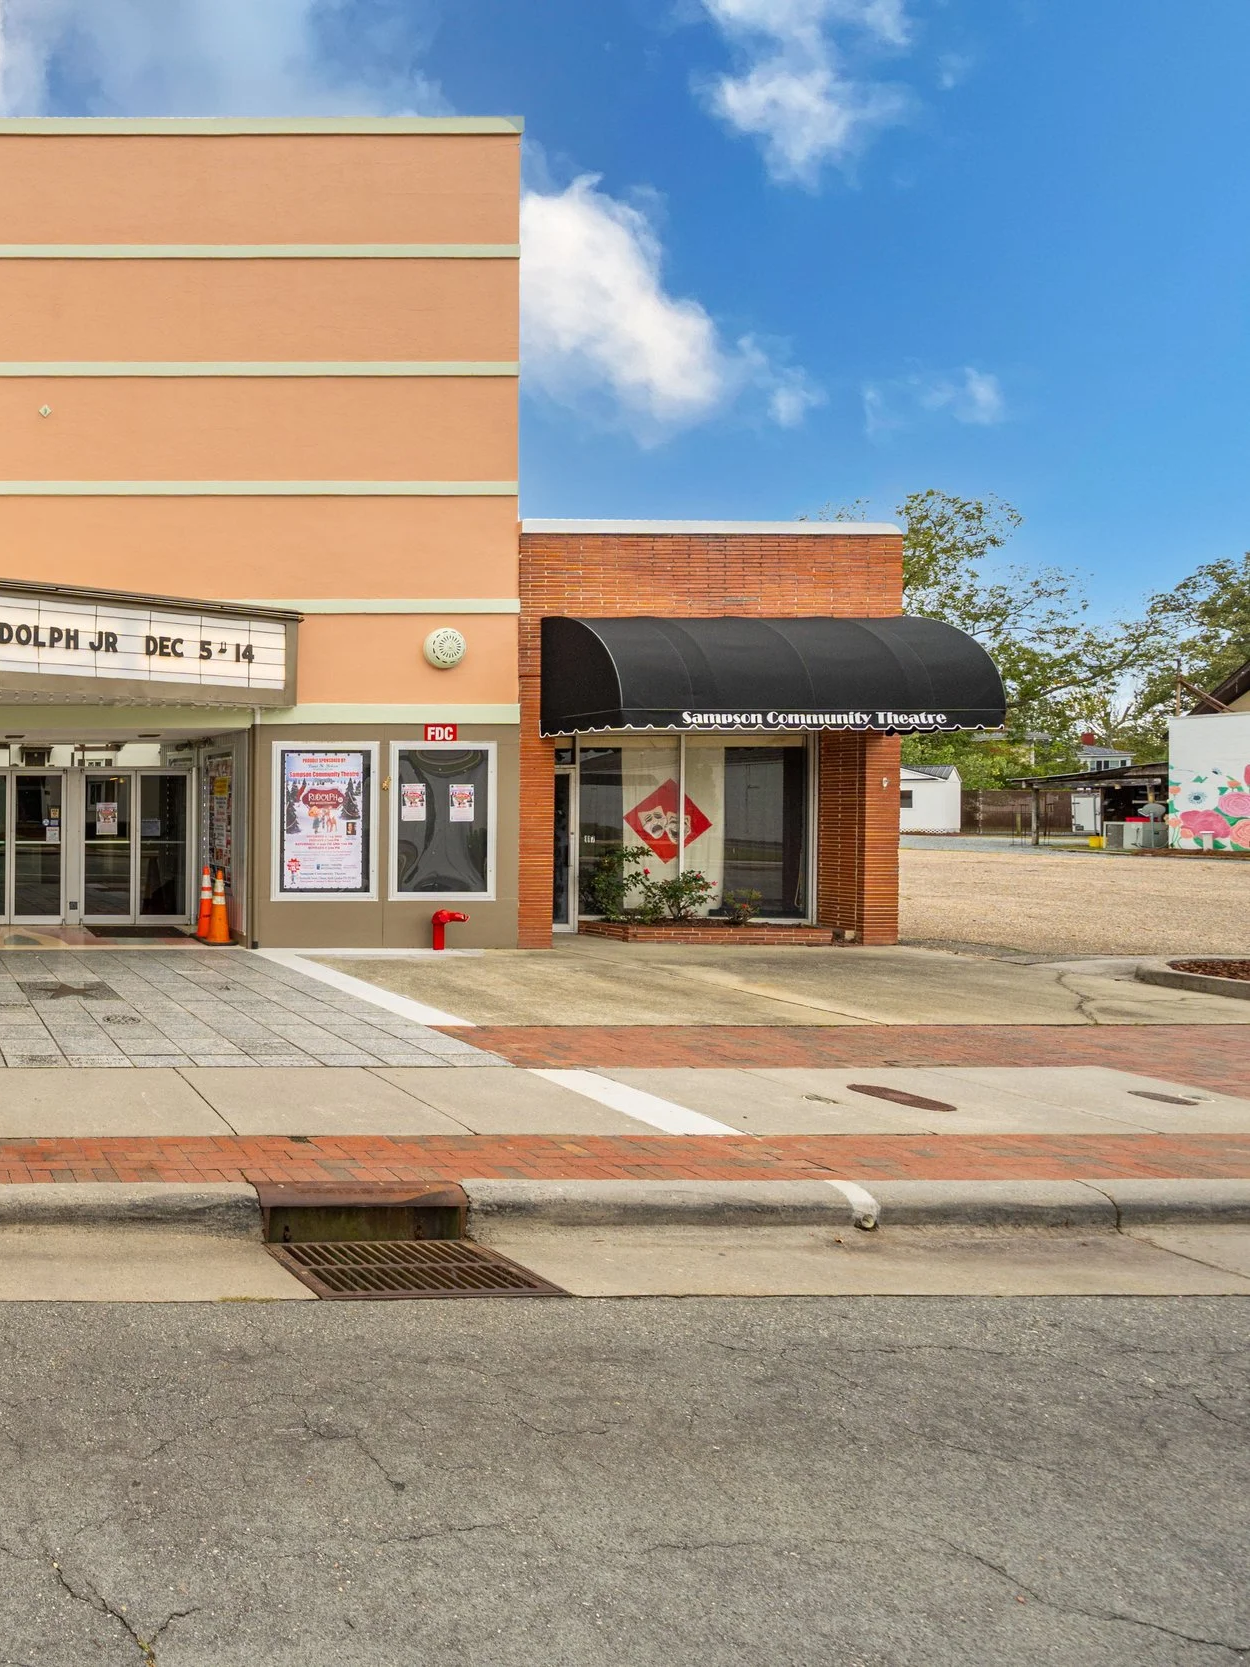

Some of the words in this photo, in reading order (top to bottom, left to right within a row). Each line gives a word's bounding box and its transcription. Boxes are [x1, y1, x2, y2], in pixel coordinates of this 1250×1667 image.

[89, 630, 118, 653] JR
[145, 635, 184, 657] DEC
[681, 711, 763, 724] Sampson
[766, 711, 872, 725] Community
[875, 711, 947, 724] Theatre
[427, 726, 453, 740] FDC
[308, 793, 337, 801] RUDOLPH
